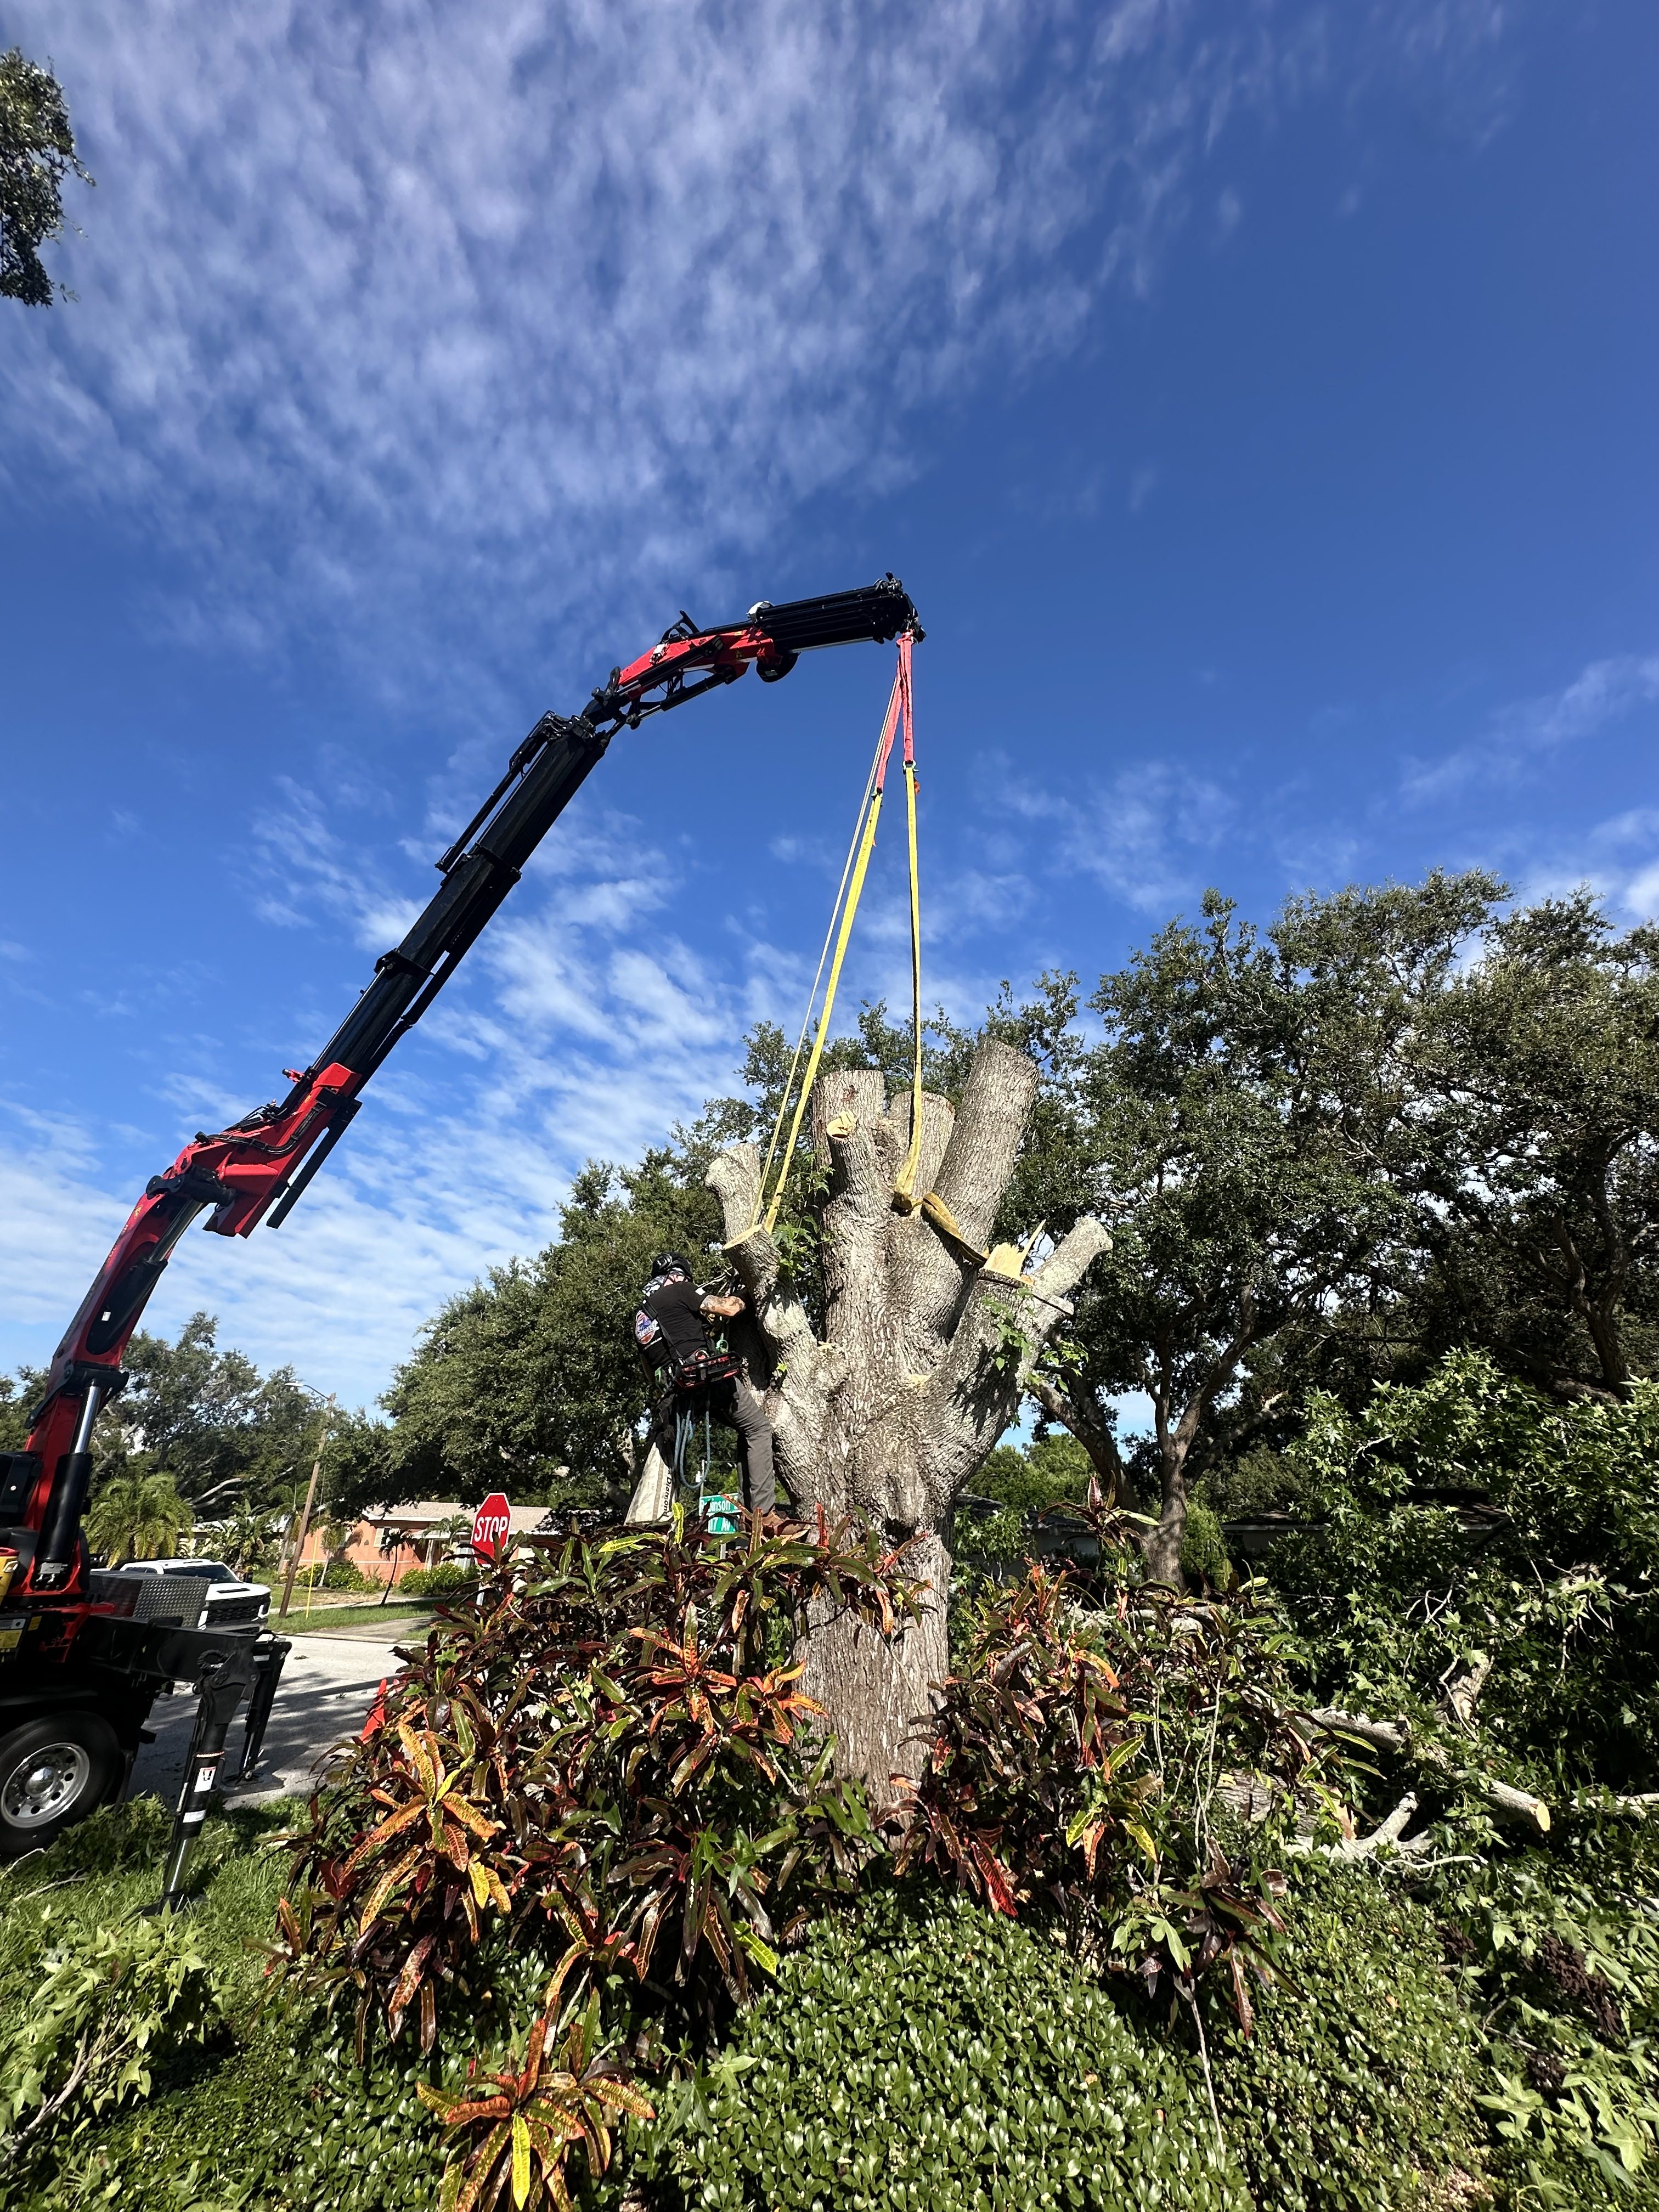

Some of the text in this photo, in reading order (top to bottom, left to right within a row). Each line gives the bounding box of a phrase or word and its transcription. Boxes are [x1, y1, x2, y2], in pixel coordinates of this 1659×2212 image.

[663, 1476, 672, 1517] Diamond
[474, 1516, 508, 1542] STOP
[709, 1516, 719, 1531] 17
